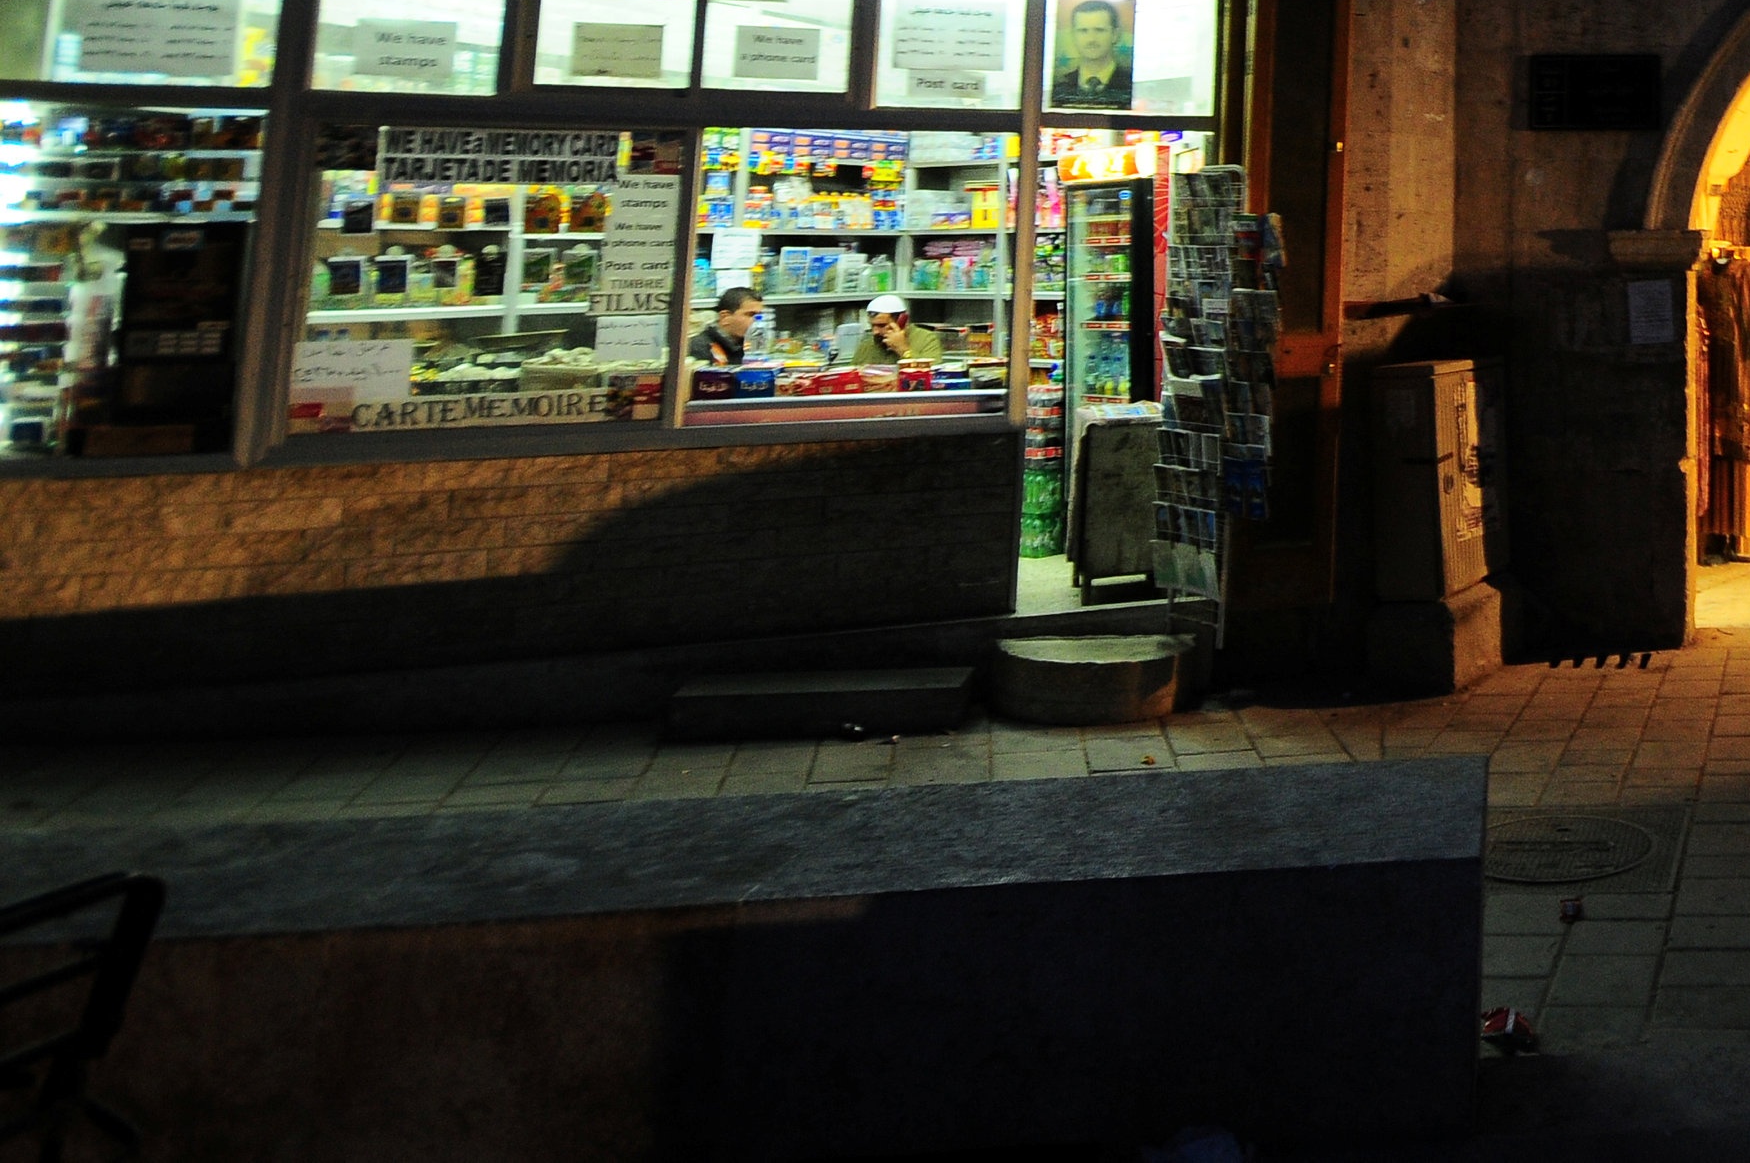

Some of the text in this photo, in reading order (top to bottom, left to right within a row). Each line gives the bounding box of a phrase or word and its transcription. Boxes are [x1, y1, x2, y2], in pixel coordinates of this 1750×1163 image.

[377, 32, 448, 47] We have
[754, 35, 804, 46] We have
[378, 56, 438, 70] stamps
[751, 54, 788, 64] phone
[791, 56, 817, 65] card
[916, 78, 980, 91] Post card
[386, 130, 416, 154] WE
[570, 133, 619, 158] CARD
[517, 159, 619, 184] MEMORIA
[619, 179, 675, 190] We have
[621, 199, 668, 210] stamps
[614, 223, 663, 231] We have
[611, 240, 646, 248] phone
[604, 260, 669, 271] Post card
[609, 278, 665, 290] TIMBRE
[589, 292, 671, 312] FILMS
